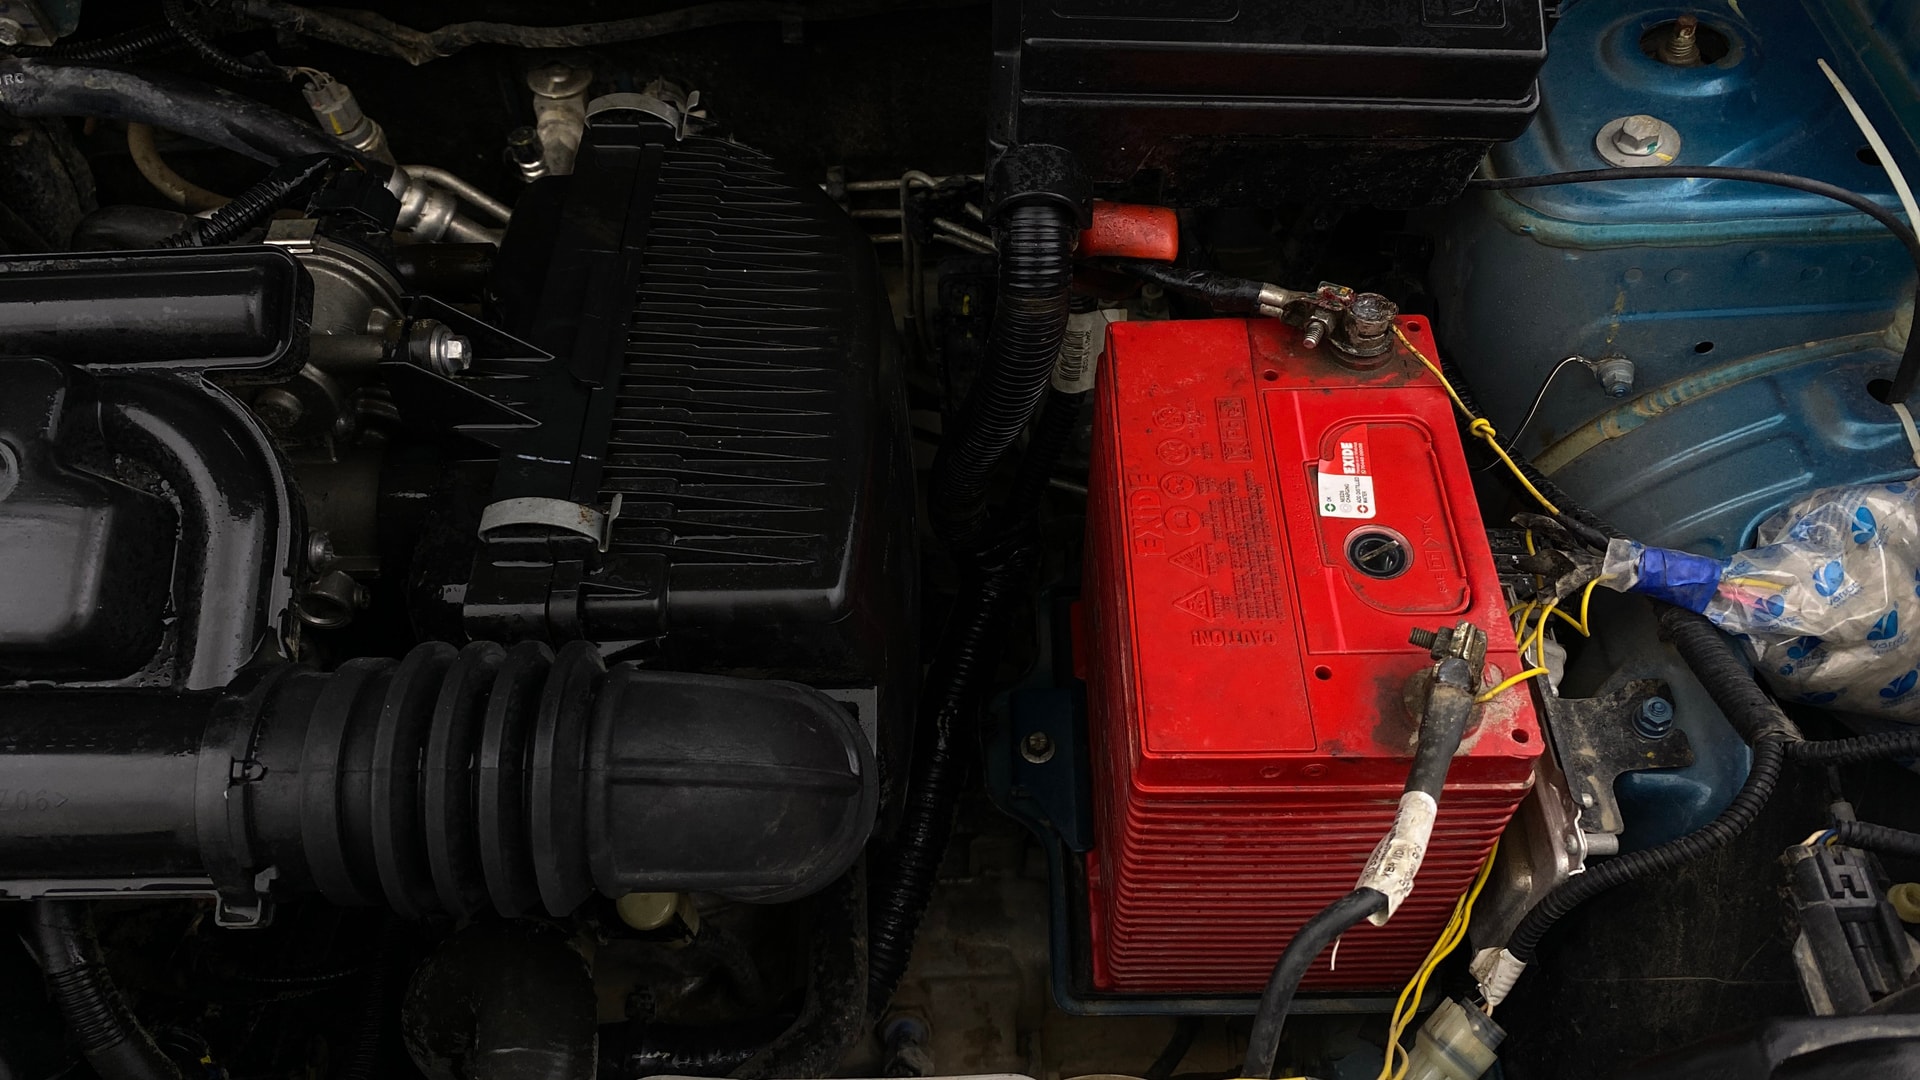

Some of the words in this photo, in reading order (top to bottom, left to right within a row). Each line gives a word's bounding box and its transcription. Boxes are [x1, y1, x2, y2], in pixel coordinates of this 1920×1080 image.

[1340, 442, 1356, 474] EXIDE
[1128, 472, 1168, 557] EXIDE
[1190, 630, 1278, 648] CAUTION!
